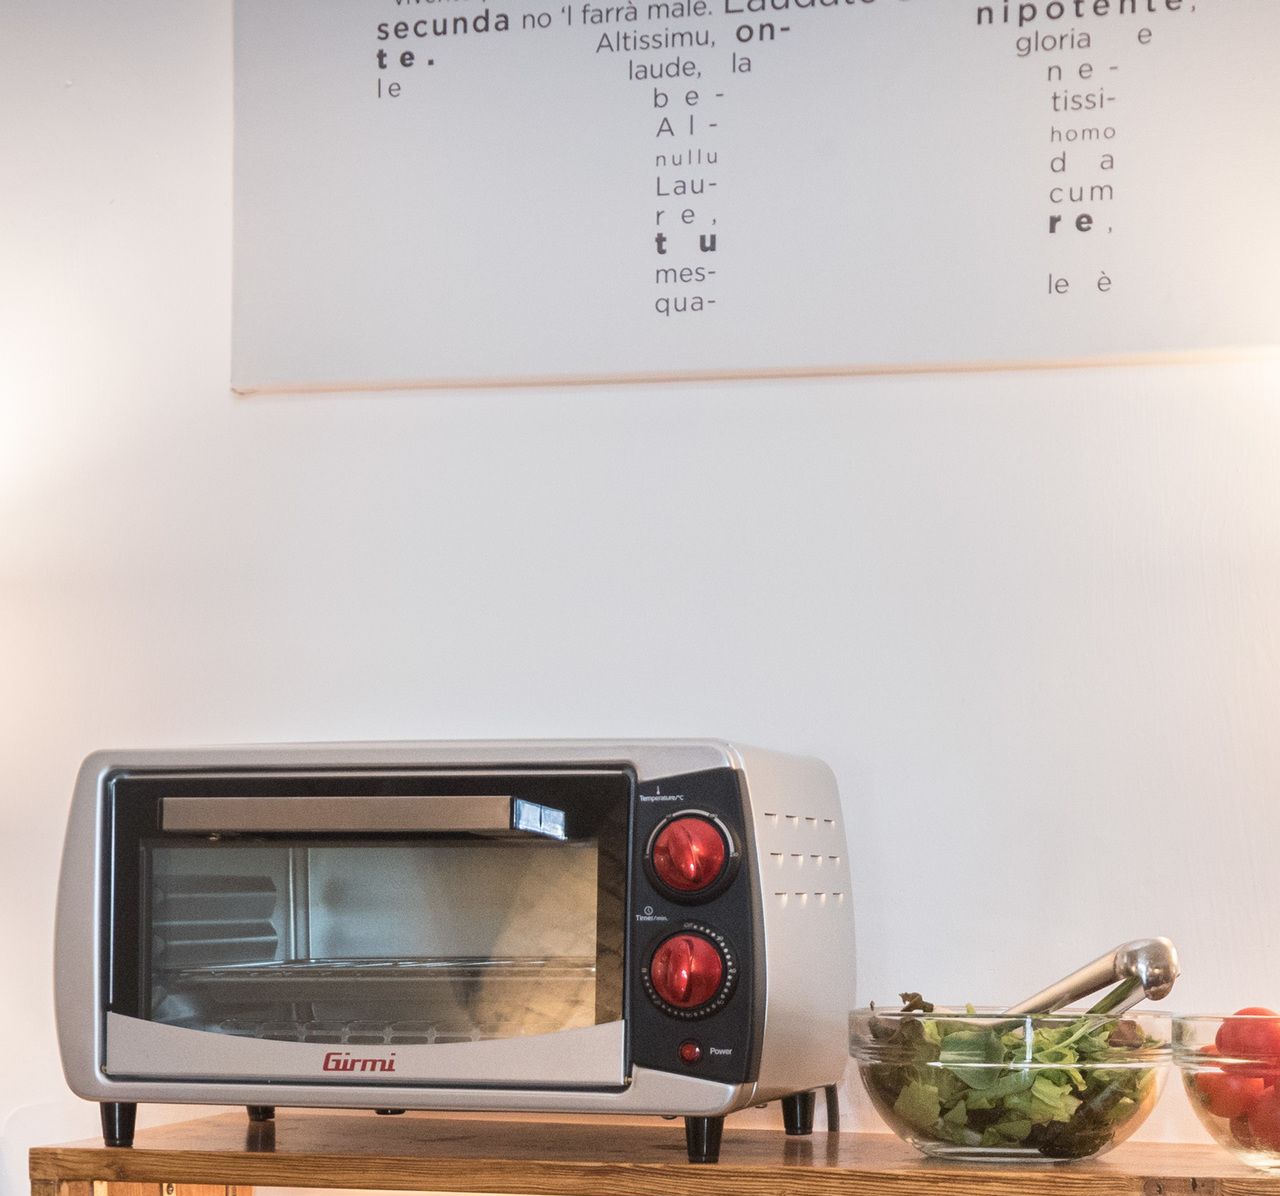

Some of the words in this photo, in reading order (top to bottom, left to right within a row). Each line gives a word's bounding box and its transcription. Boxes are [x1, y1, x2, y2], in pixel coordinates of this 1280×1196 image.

[377, 8, 510, 41] secunda
[522, 12, 553, 30] no
[647, 0, 713, 20] male.
[595, 29, 716, 54] Altissimu,
[735, 22, 791, 44] on-
[1015, 30, 1092, 58] gloria
[1136, 27, 1153, 46] e
[628, 56, 702, 81] laude,
[731, 51, 752, 74] la
[377, 77, 402, 99] le
[1051, 89, 1116, 113] tissi-
[1050, 125, 1117, 143] homo
[655, 148, 718, 168] nullu
[656, 176, 717, 197] Lau-
[1048, 184, 1114, 204] cum
[655, 266, 716, 285] mes-
[1047, 273, 1070, 295] le
[1096, 270, 1112, 293] è
[654, 295, 716, 317] qua-
[322, 1051, 397, 1072] Girmi
[709, 1047, 733, 1055] Power
